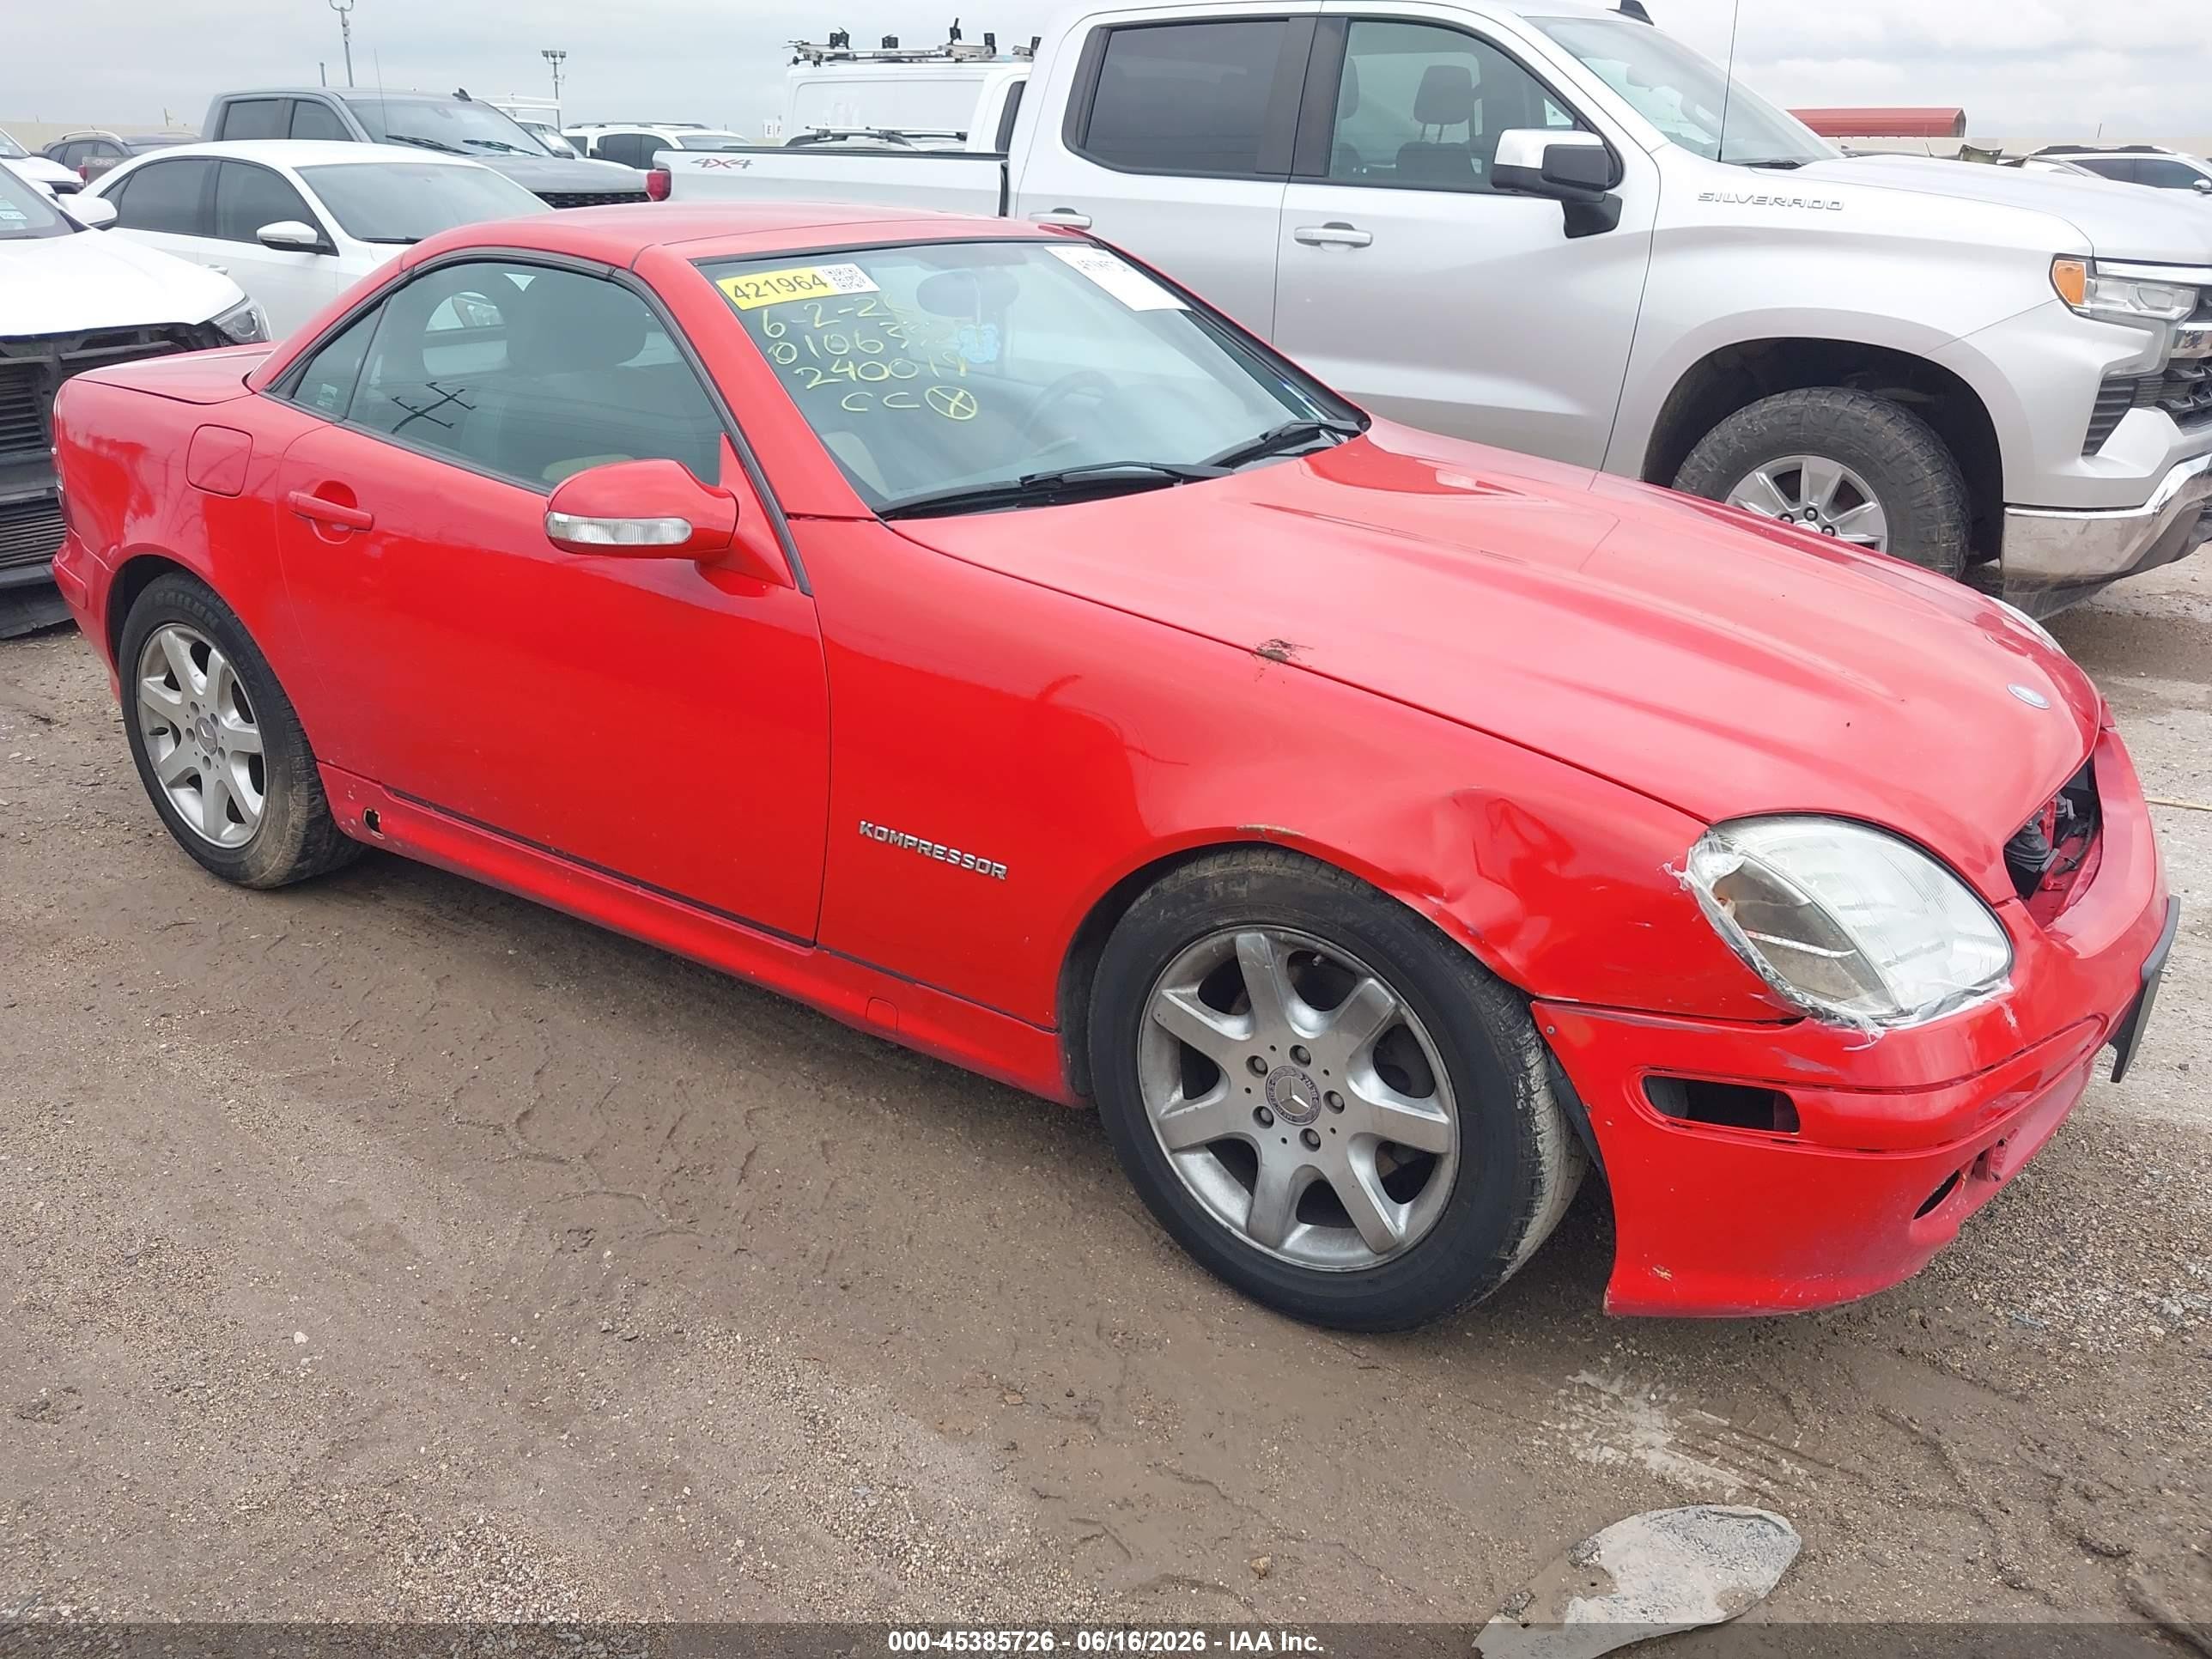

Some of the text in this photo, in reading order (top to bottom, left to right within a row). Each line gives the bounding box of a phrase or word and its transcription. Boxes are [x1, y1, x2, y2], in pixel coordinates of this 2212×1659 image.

[1698, 191, 1845, 211] SILVERADO
[734, 274, 829, 301] 421964
[859, 820, 1007, 880] KOMPRESSOR
